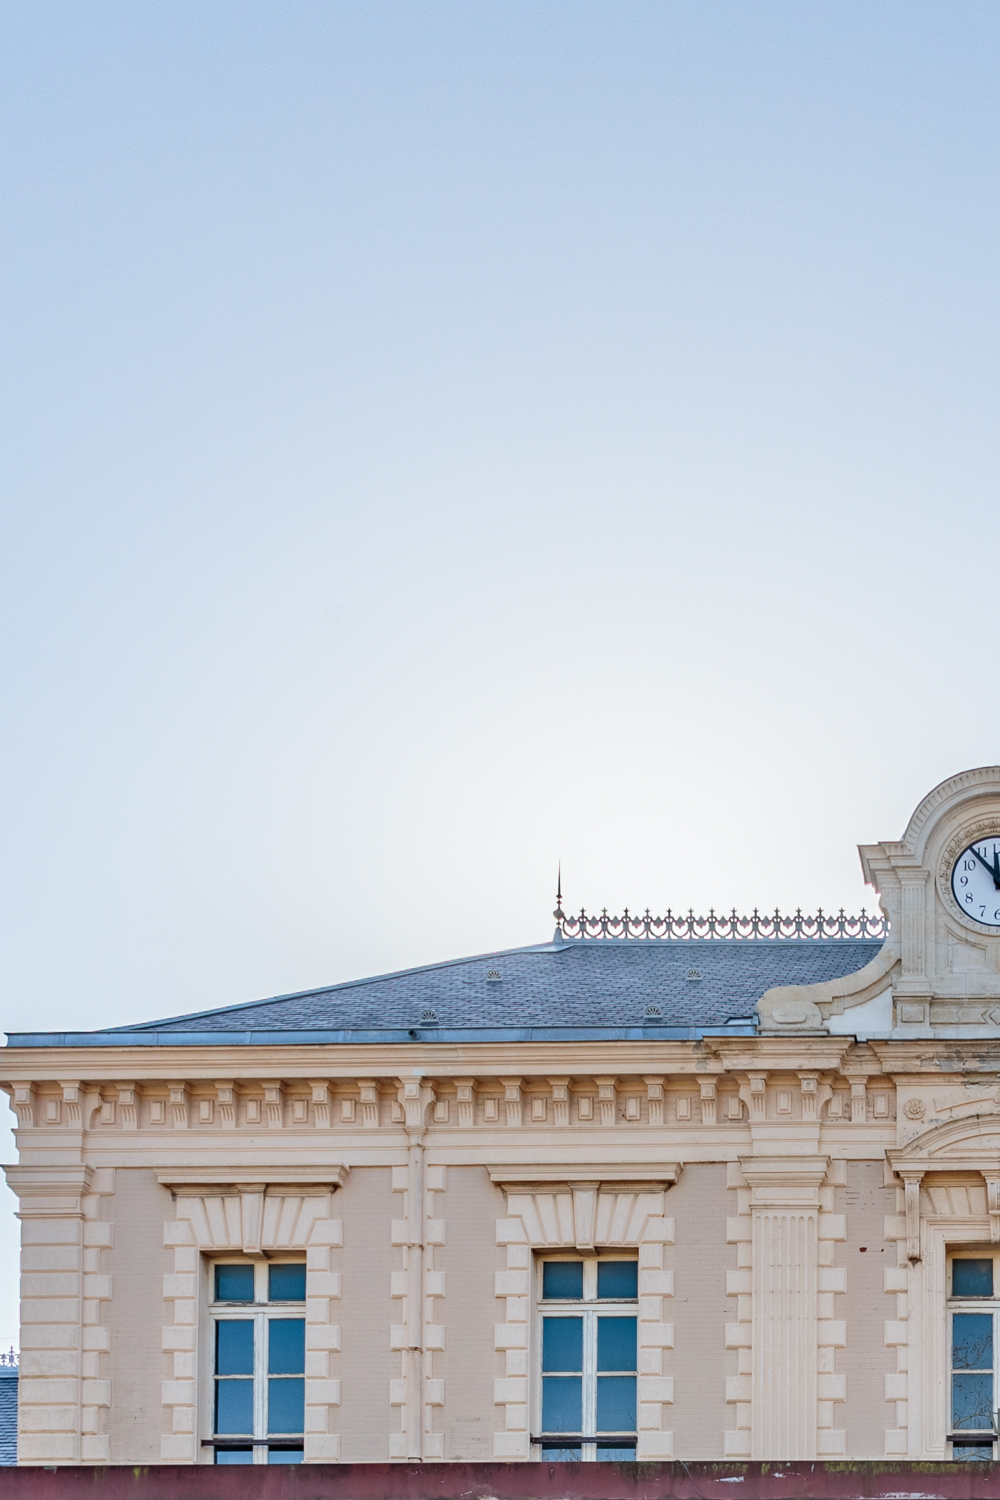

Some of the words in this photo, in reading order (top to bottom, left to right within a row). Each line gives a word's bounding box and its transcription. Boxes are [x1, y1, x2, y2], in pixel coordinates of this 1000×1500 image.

[977, 847, 987, 857] 11
[963, 859, 976, 871] 10
[960, 876, 968, 887] 9
[965, 892, 973, 904] 8
[979, 905, 986, 917] 7
